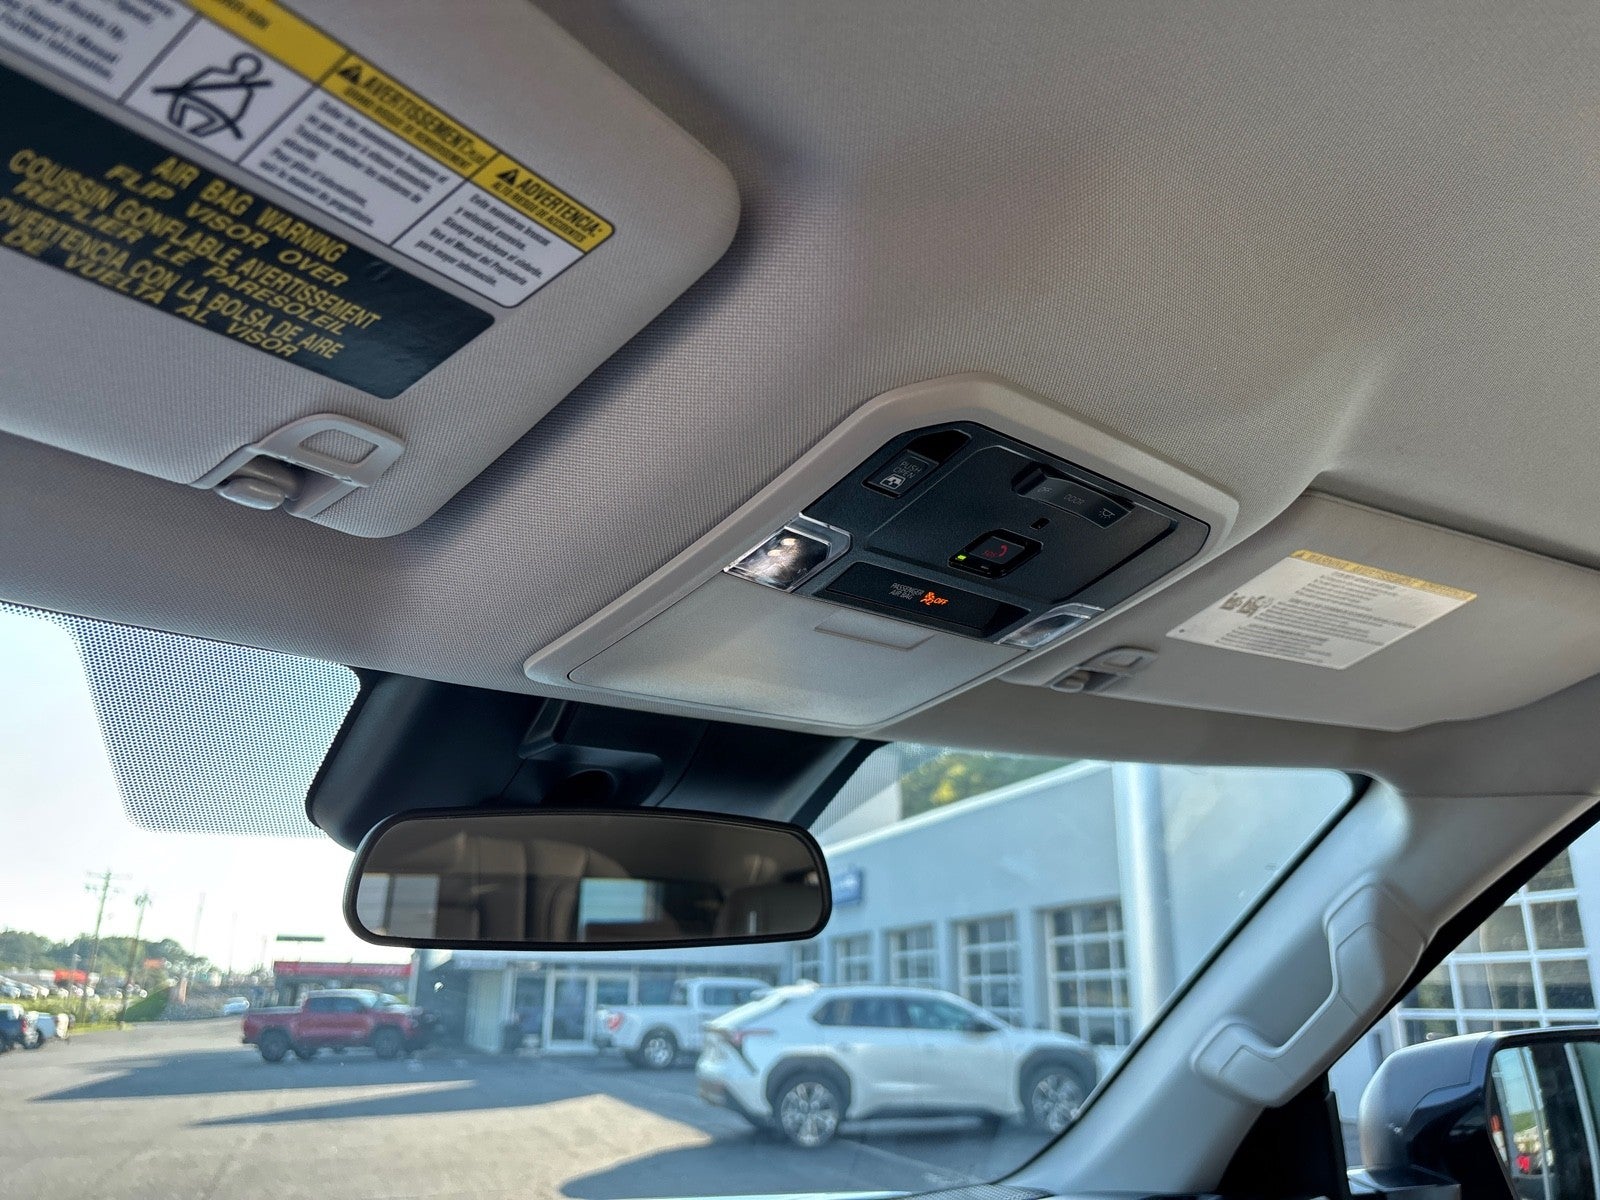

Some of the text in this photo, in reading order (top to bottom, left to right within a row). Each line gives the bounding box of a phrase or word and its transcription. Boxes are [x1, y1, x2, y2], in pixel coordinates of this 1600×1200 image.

[9, 150, 382, 329] COUSSIN GONFLABLE AVERTISSEMENT
[105, 164, 349, 287] FLIP VISOR OVER
[152, 156, 200, 190] AIR
[200, 180, 254, 217] BAG
[255, 206, 349, 263] WARNING
[0, 197, 345, 360] DVERTENCIA CON LA BOLSA DE AIRE
[63, 254, 167, 305] VUELTA
[174, 303, 209, 325] AL
[226, 321, 300, 358] VISOR
[154, 243, 200, 267] LE
[202, 266, 347, 336] PARESOLEIL
[899, 460, 923, 474] PUSH
[890, 582, 925, 597] PASSENGER
[933, 597, 949, 605] OFF
